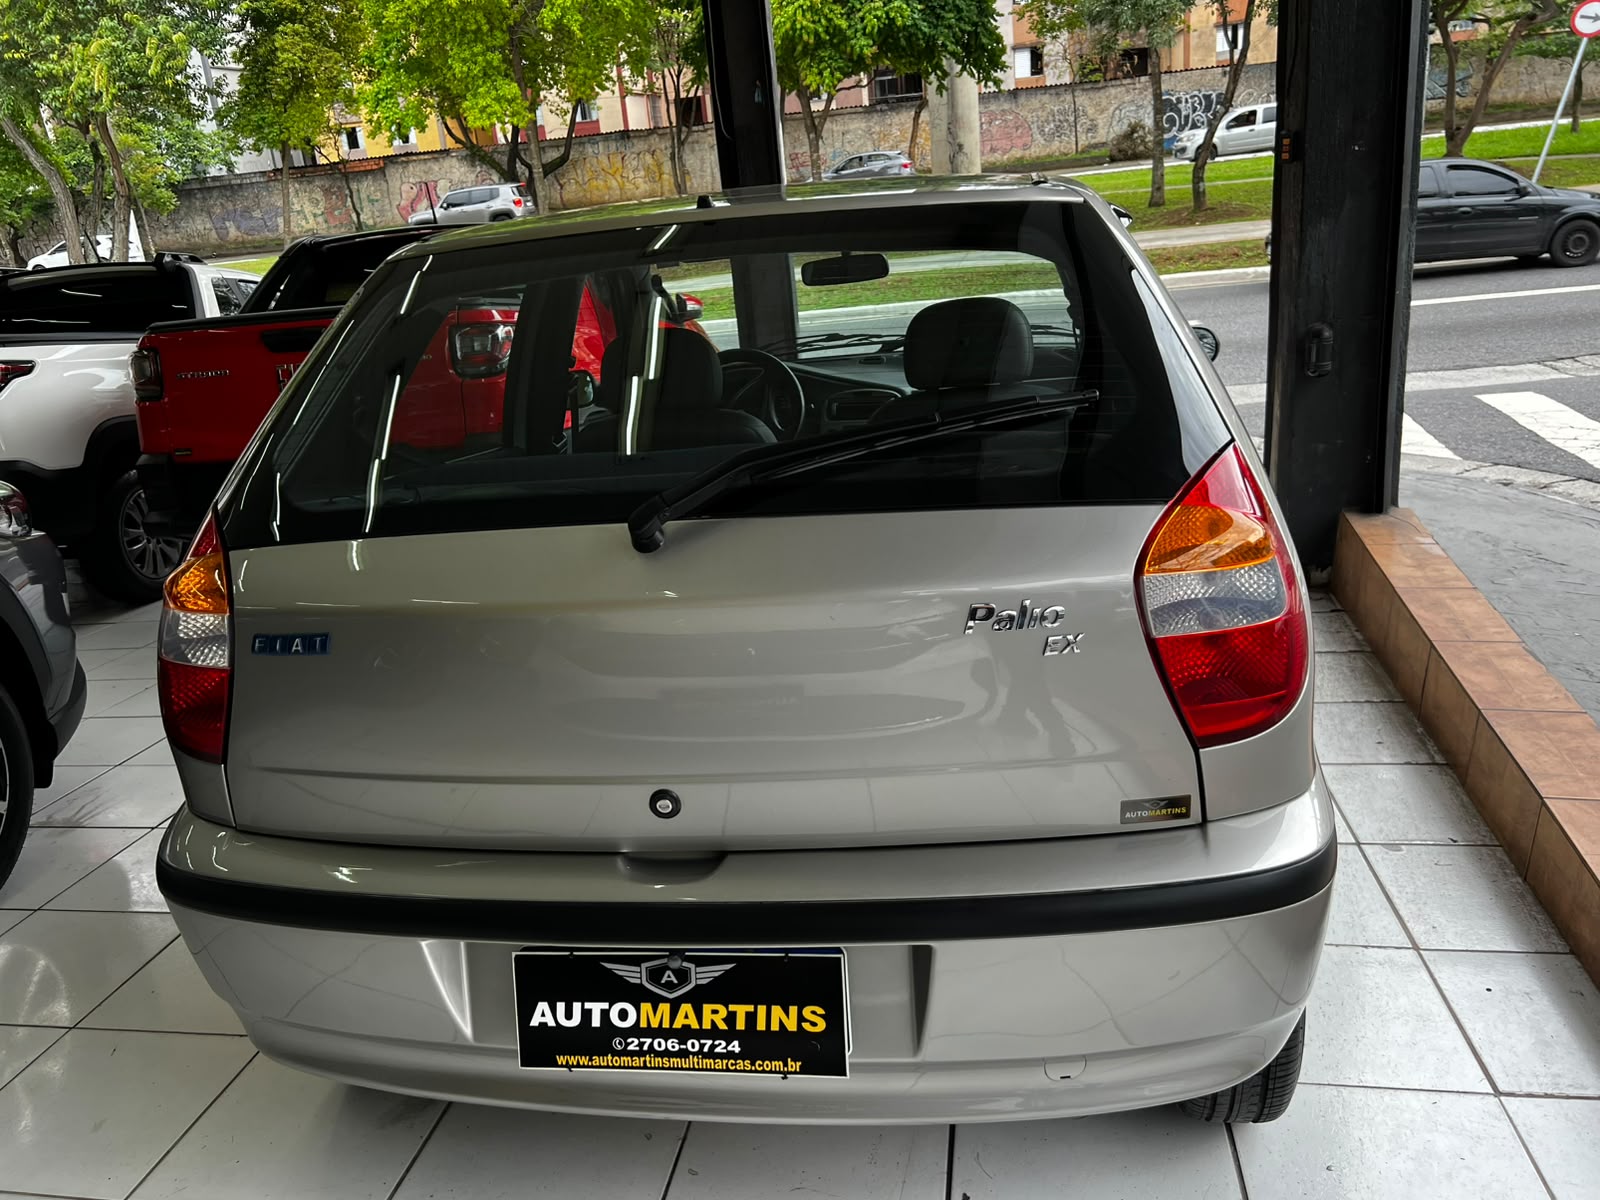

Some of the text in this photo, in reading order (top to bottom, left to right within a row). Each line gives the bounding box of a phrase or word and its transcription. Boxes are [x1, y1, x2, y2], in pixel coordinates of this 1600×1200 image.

[963, 599, 1065, 635] Palio
[253, 635, 328, 654] FIAT
[1043, 633, 1085, 656] EX
[1125, 807, 1187, 818] AUTOMARTINS
[529, 1001, 827, 1032] AUTOMARTINS
[626, 1037, 741, 1053] 2706-0724
[556, 1053, 802, 1073] www.automartinsmultimarcas.com.br
